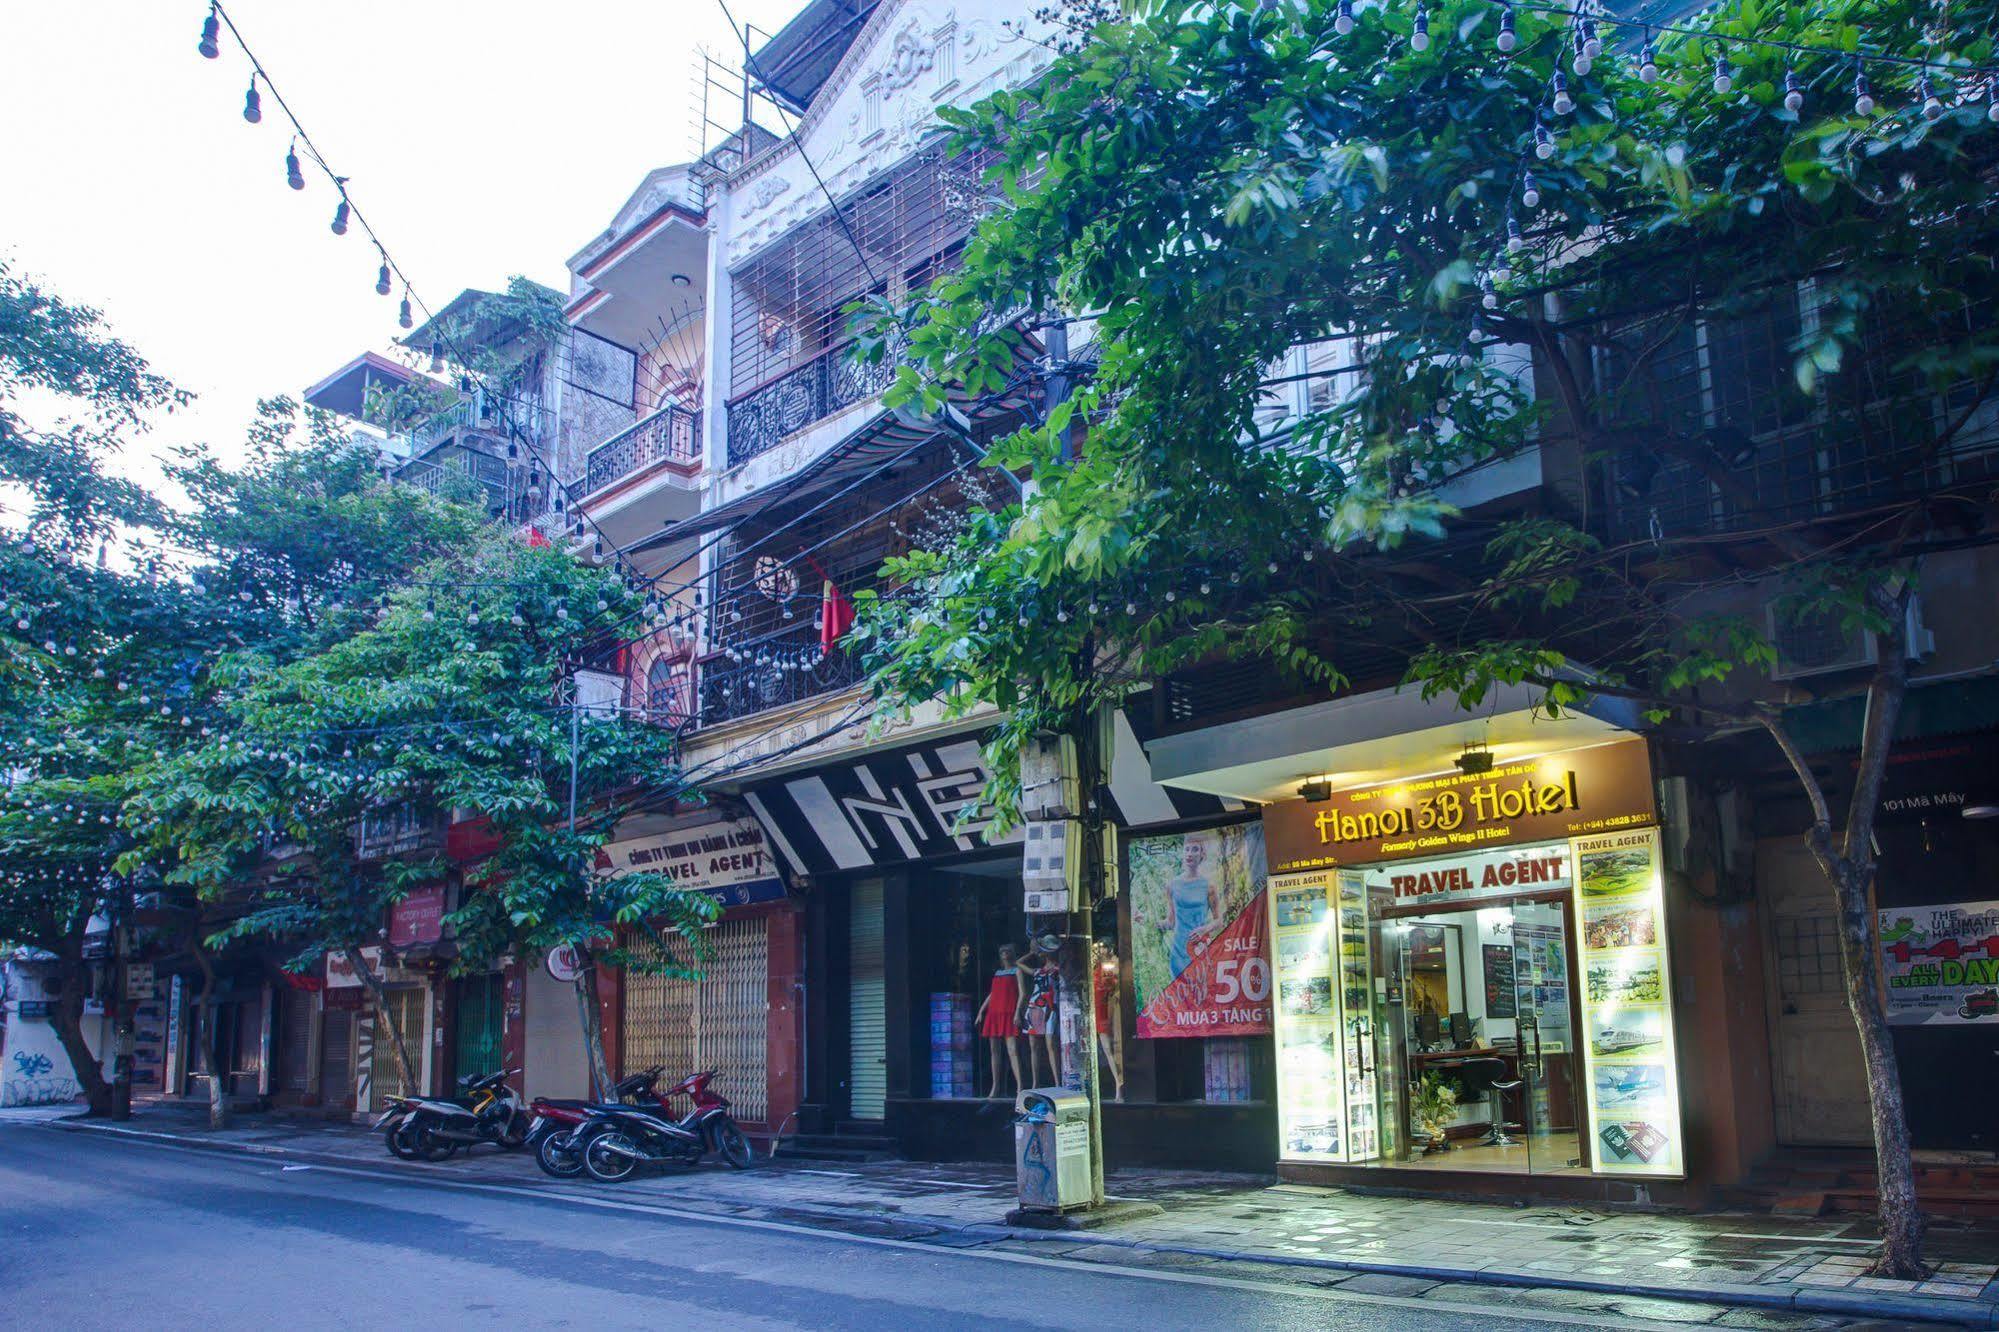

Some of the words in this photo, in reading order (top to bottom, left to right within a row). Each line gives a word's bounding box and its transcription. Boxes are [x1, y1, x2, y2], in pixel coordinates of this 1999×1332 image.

[1315, 808, 1410, 843] Hanoi
[1417, 790, 1465, 830] 3B
[1470, 767, 1575, 822] Hotel
[1883, 799, 1904, 811] 101
[1567, 823, 1581, 831] Tel:
[1381, 839, 1416, 853] Formerly
[1417, 836, 1448, 847] Golden
[1448, 832, 1475, 844] Wings
[1486, 826, 1510, 838] Hotel
[1577, 839, 1613, 851] TRAVEL
[1617, 834, 1651, 847] AGENT
[651, 847, 664, 862] TY
[1134, 841, 1178, 856] NEM
[709, 850, 764, 874] AGENT
[1275, 879, 1300, 888] TRAVEL
[1303, 875, 1327, 884] AGENT
[1391, 867, 1474, 898] TRAVEL
[1481, 857, 1563, 888] AGENT
[1931, 910, 1957, 920] THE
[1931, 917, 1999, 930] ULTIMATE
[1224, 936, 1257, 952] SALE
[1891, 975, 1940, 988] EVERY
[1942, 959, 1999, 986] DAY
[1911, 963, 1939, 975] ALL
[1177, 1010, 1209, 1025] MUA
[1210, 1010, 1218, 1024] 3
